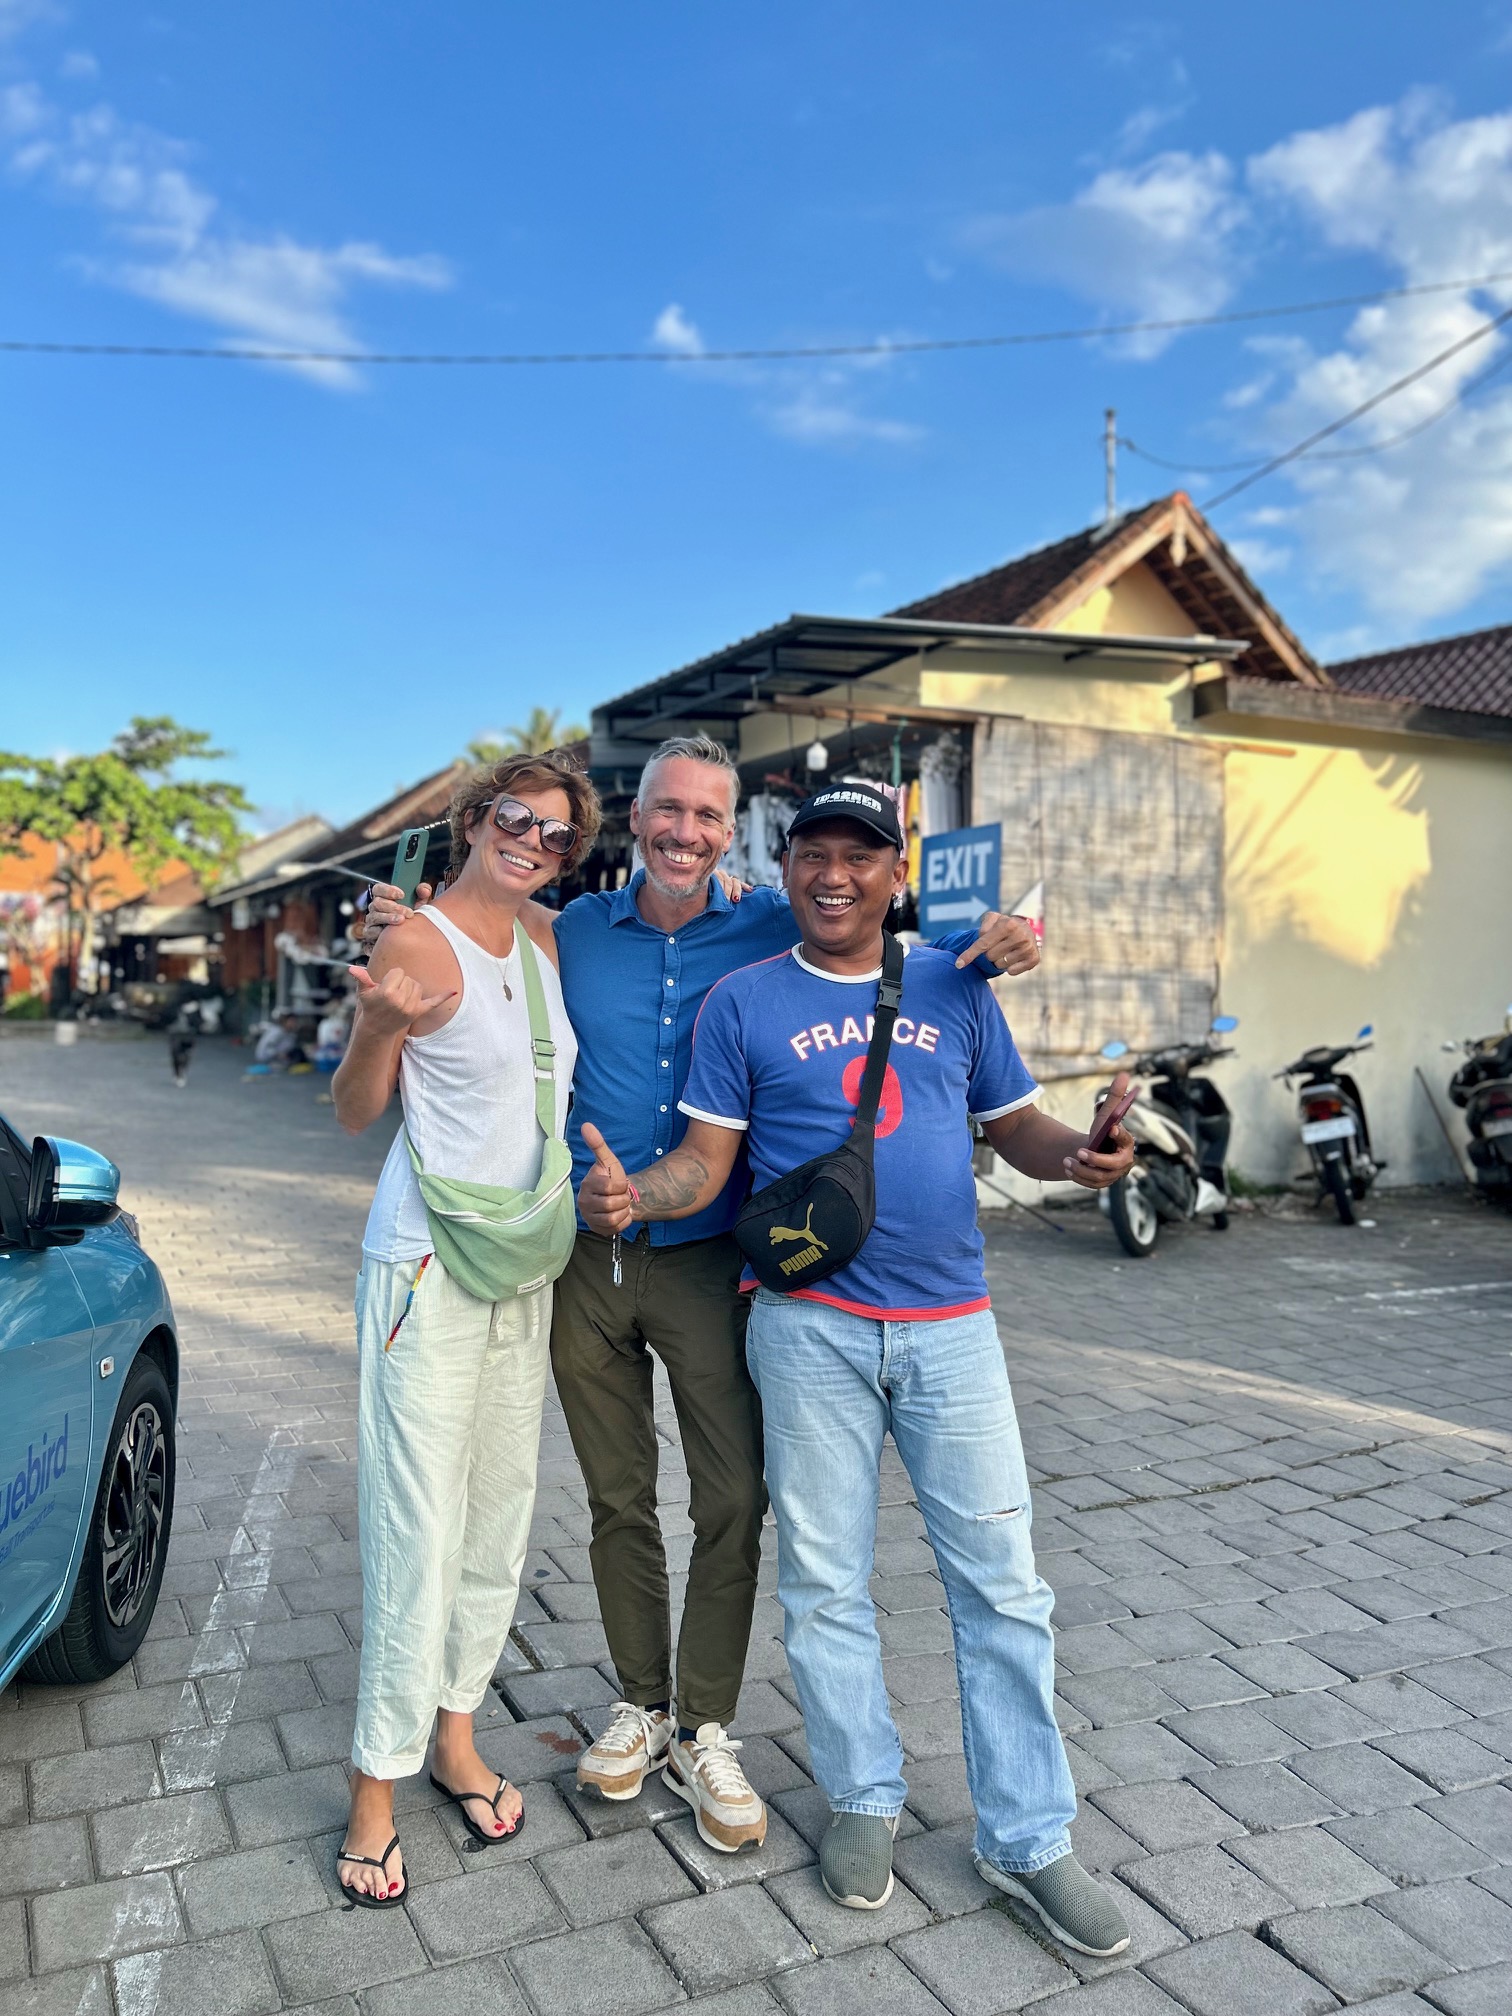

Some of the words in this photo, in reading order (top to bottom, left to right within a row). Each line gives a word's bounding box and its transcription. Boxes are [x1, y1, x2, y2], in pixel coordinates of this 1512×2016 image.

[927, 841, 993, 893] EXIT
[841, 1055, 904, 1139] 9
[779, 1245, 823, 1276] PUMA
